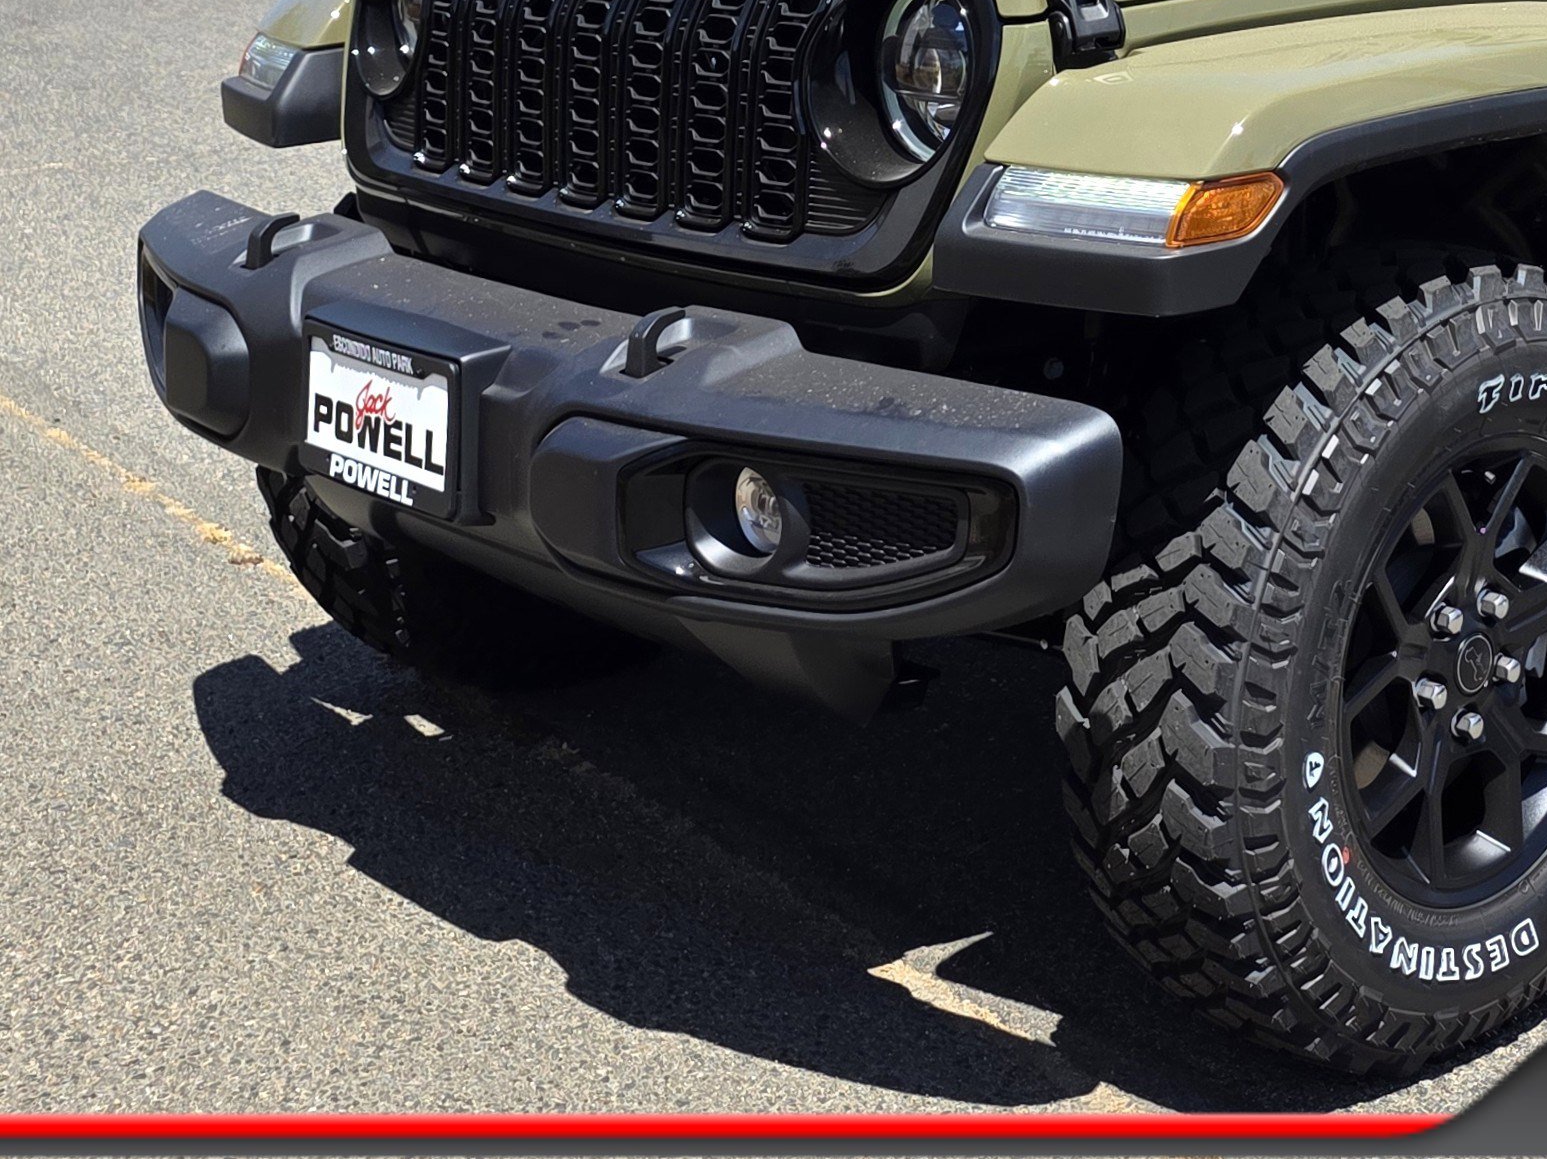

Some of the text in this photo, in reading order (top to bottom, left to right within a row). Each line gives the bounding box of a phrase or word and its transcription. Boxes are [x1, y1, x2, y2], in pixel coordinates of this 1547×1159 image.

[313, 392, 445, 477] POWELL
[355, 379, 396, 431] Jack
[328, 453, 414, 507] POWELL
[1308, 797, 1541, 982] DESTINATION
